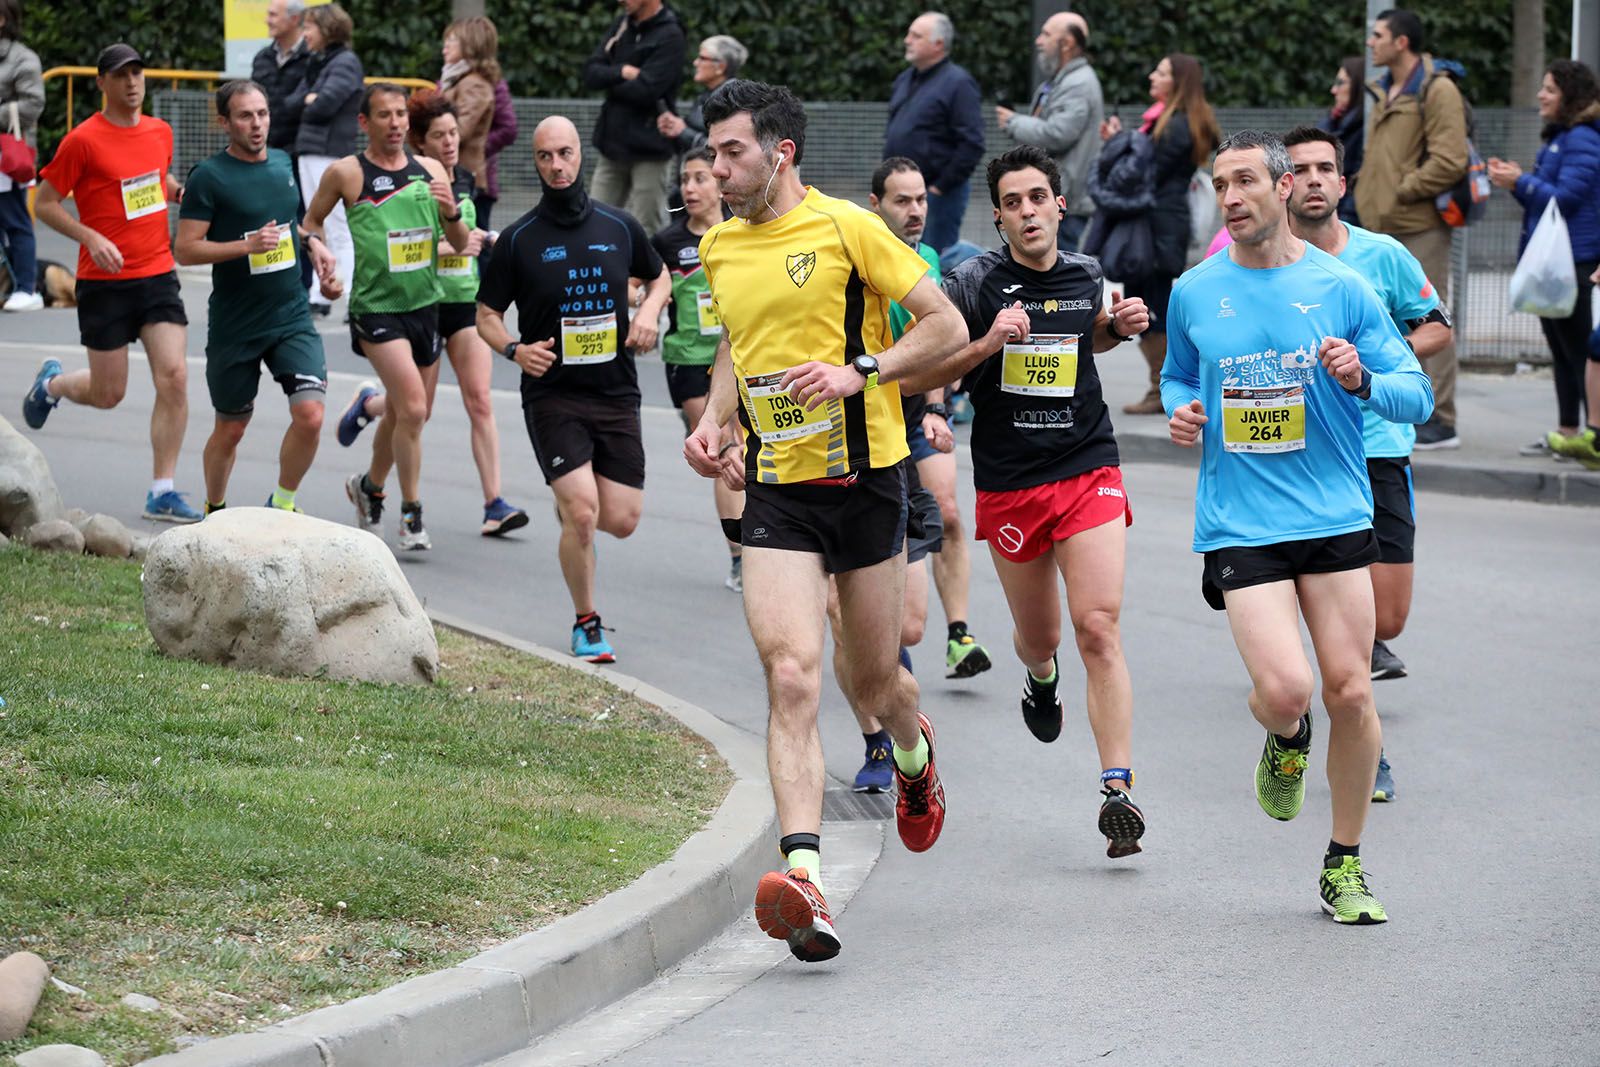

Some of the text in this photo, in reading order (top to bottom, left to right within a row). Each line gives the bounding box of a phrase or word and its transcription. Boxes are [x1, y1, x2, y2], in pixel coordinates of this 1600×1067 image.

[568, 266, 602, 280] RUN
[564, 283, 608, 297] YOUR
[559, 299, 614, 313] WORLD
[1002, 301, 1044, 311] SADAÑA
[575, 331, 608, 343] OSCAR
[582, 343, 603, 355] 273
[1219, 348, 1277, 368] 20 anys de
[1240, 359, 1281, 376] SANT
[1026, 370, 1056, 385] 769
[768, 395, 799, 411] TON
[773, 408, 805, 429] 898
[1240, 409, 1290, 424] JAVIER
[1249, 425, 1282, 441] 264
